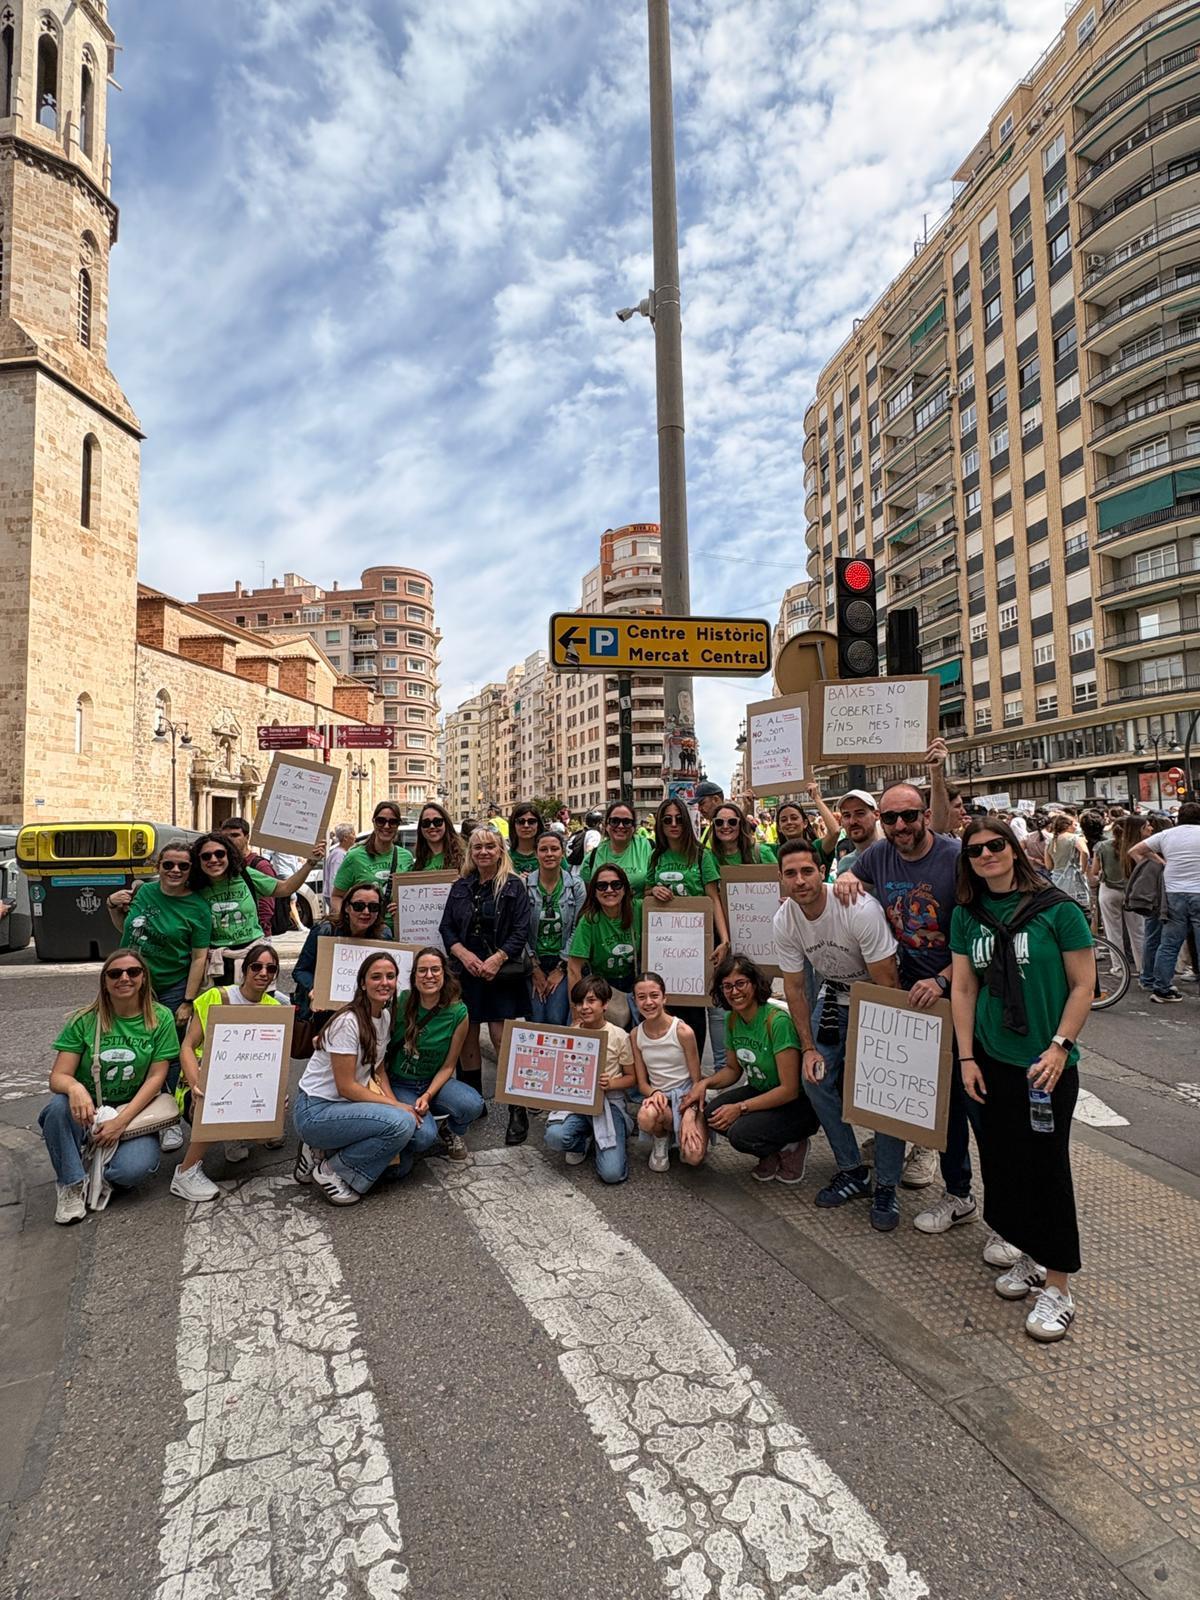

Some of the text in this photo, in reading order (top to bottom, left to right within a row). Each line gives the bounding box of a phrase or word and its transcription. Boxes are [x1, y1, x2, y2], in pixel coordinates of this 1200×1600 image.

[626, 624, 765, 642] Centre Històric
[595, 630, 614, 654] P
[629, 647, 765, 664] Mercat Central
[828, 684, 906, 701] BAIXES NO
[830, 702, 893, 717] COBERTES
[755, 719, 762, 728] 2
[767, 716, 782, 726] AL
[868, 720, 890, 731] MES
[903, 720, 920, 729] MIG
[752, 727, 785, 738] NO SOM
[836, 732, 883, 747] DESPRÉS
[283, 768, 291, 777] 2
[294, 770, 305, 780] AL
[292, 783, 305, 791] SOM
[418, 887, 431, 899] PT
[728, 885, 739, 896] LA
[401, 904, 416, 913] NO
[730, 902, 755, 911] SENSE
[651, 916, 662, 927] LA
[736, 913, 771, 923] RECURSOS
[738, 924, 752, 939] ÉS
[340, 949, 370, 963] BAIXE
[663, 948, 699, 958] RECURSOS
[336, 967, 357, 977] COBE
[336, 984, 351, 993] MES
[664, 975, 704, 993] CLUSIÓ
[860, 1005, 940, 1044] LLUITEM
[243, 1029, 257, 1041] PT
[215, 1050, 227, 1061] NO
[863, 1035, 909, 1064] PELS
[860, 1062, 936, 1097] VOSTRES
[856, 1083, 929, 1119] FILLS/ES
